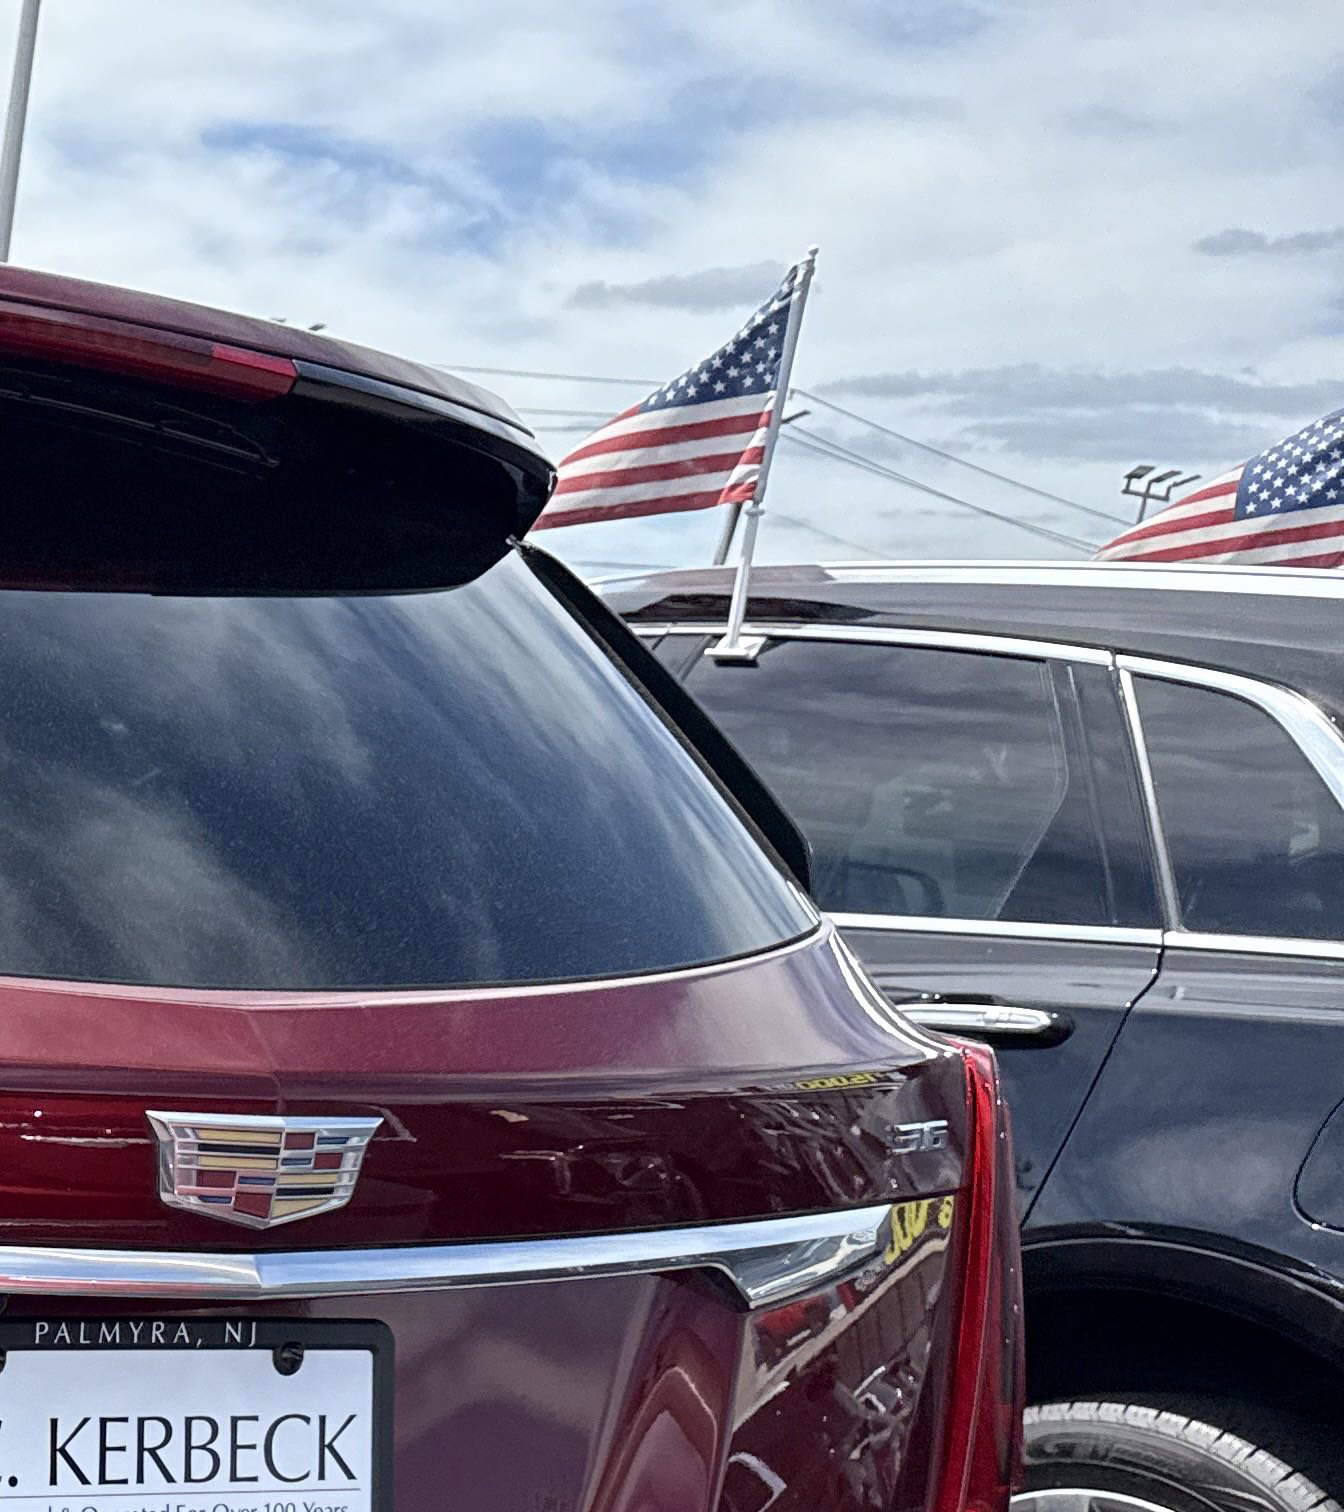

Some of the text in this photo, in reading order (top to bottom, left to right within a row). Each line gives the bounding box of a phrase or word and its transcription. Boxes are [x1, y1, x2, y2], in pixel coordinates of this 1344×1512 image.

[34, 1320, 259, 1348] PALMYRA, NJ
[48, 1412, 358, 1487] KERBECK
